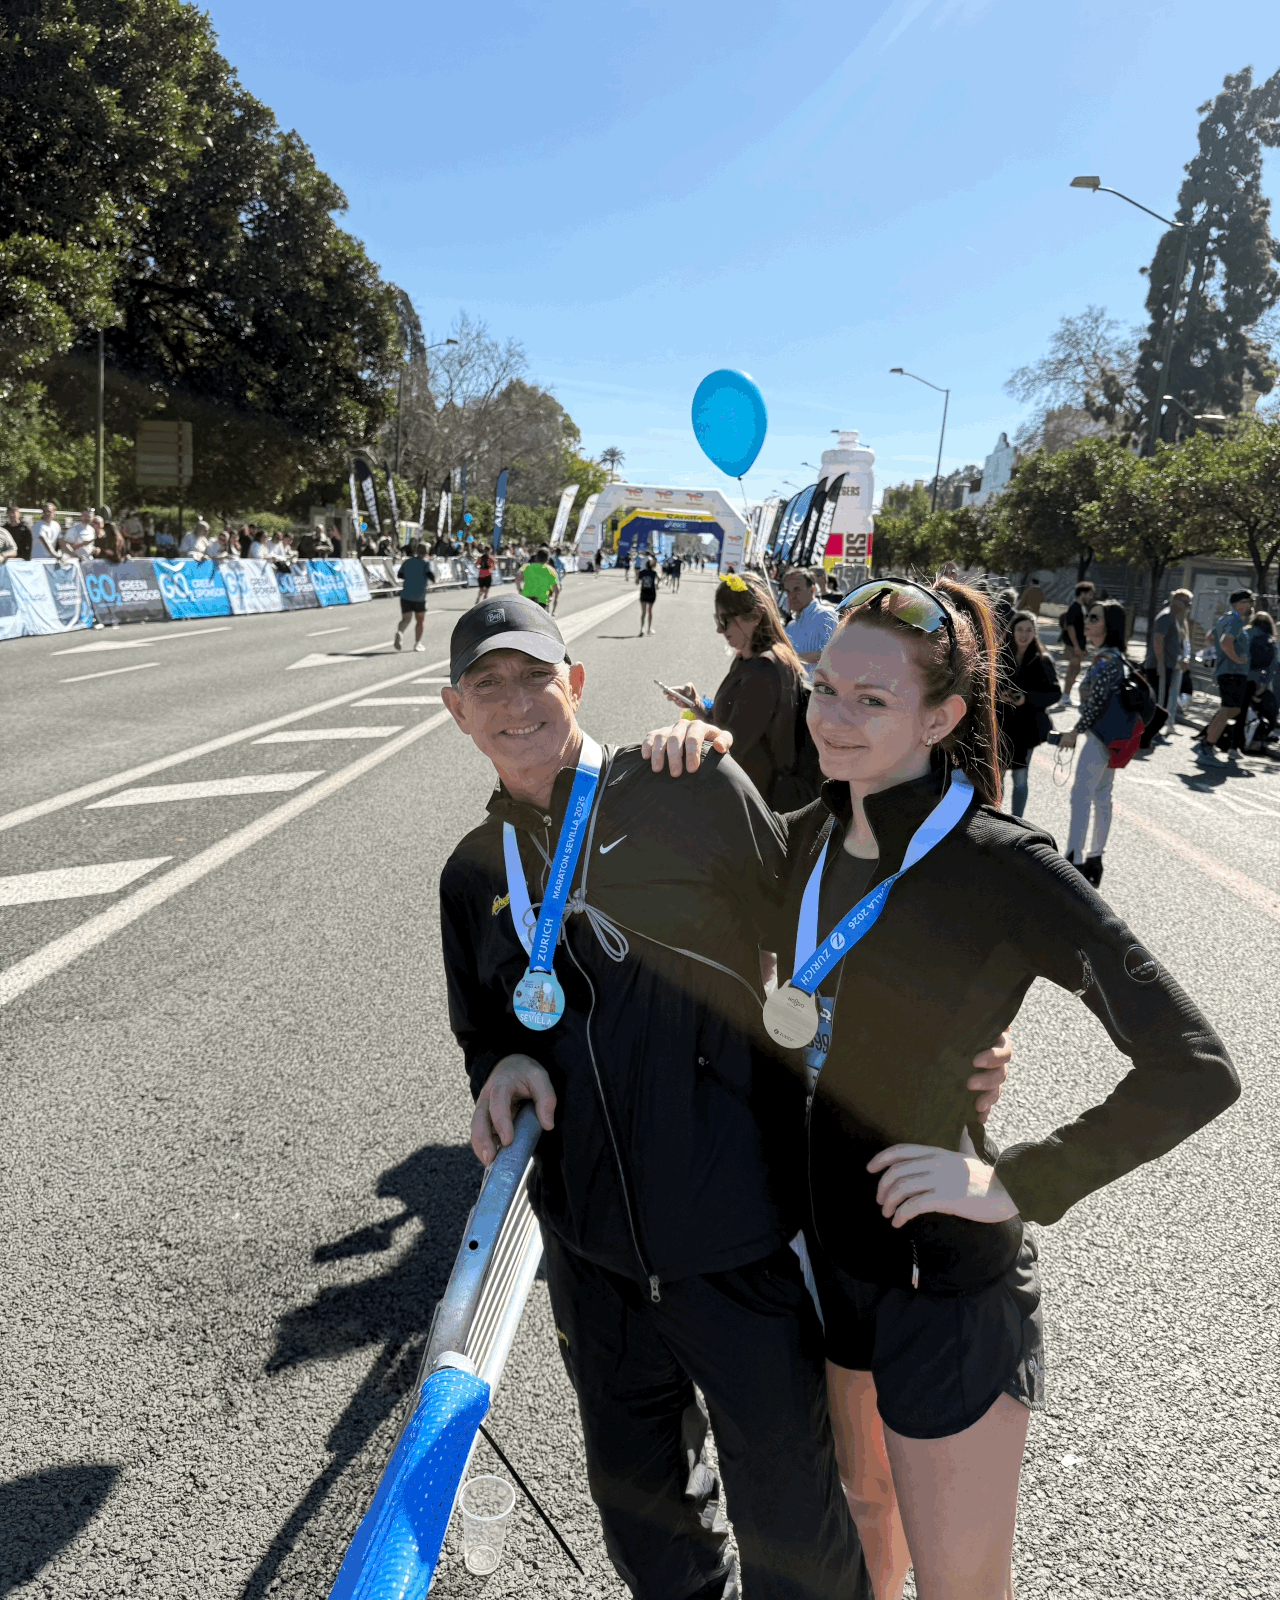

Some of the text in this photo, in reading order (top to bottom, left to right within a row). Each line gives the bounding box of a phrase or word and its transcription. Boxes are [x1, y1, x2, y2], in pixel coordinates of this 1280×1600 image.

[537, 795, 586, 962] ZURICH MARATON SEVILLA 2026
[848, 908, 869, 930] 2026
[800, 948, 831, 986] ZURICH
[519, 1013, 552, 1025] SEVILLA
